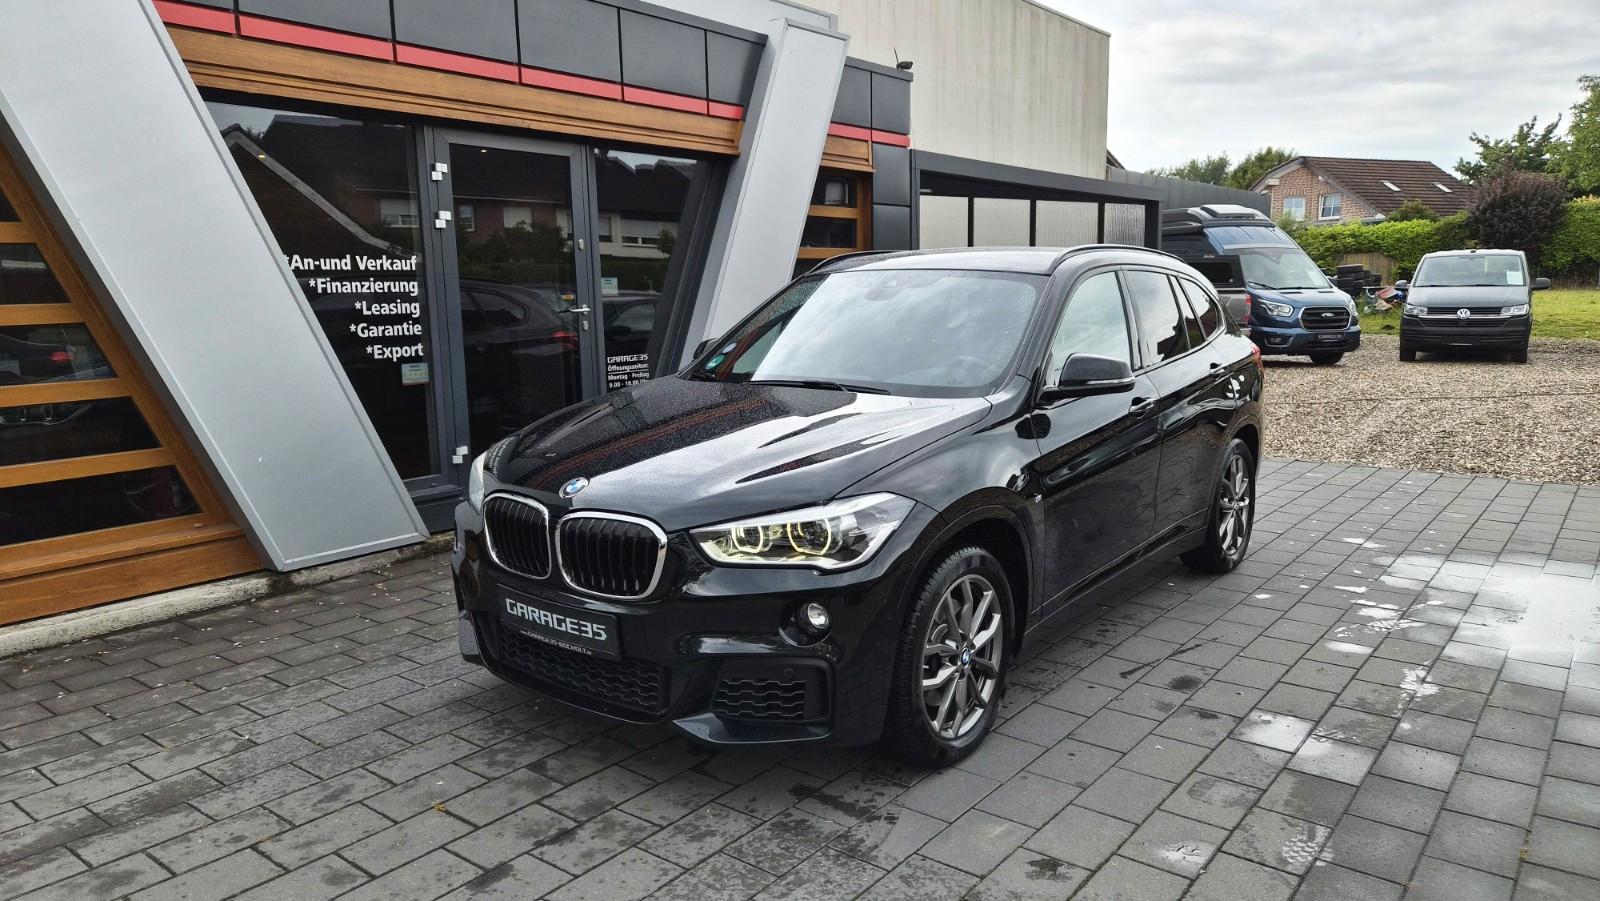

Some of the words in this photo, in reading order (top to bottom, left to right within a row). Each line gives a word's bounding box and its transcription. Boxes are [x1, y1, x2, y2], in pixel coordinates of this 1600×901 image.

[355, 255, 417, 271] Verkauf
[607, 354, 649, 364] GARAGE35
[505, 598, 608, 641] GARAGE35
